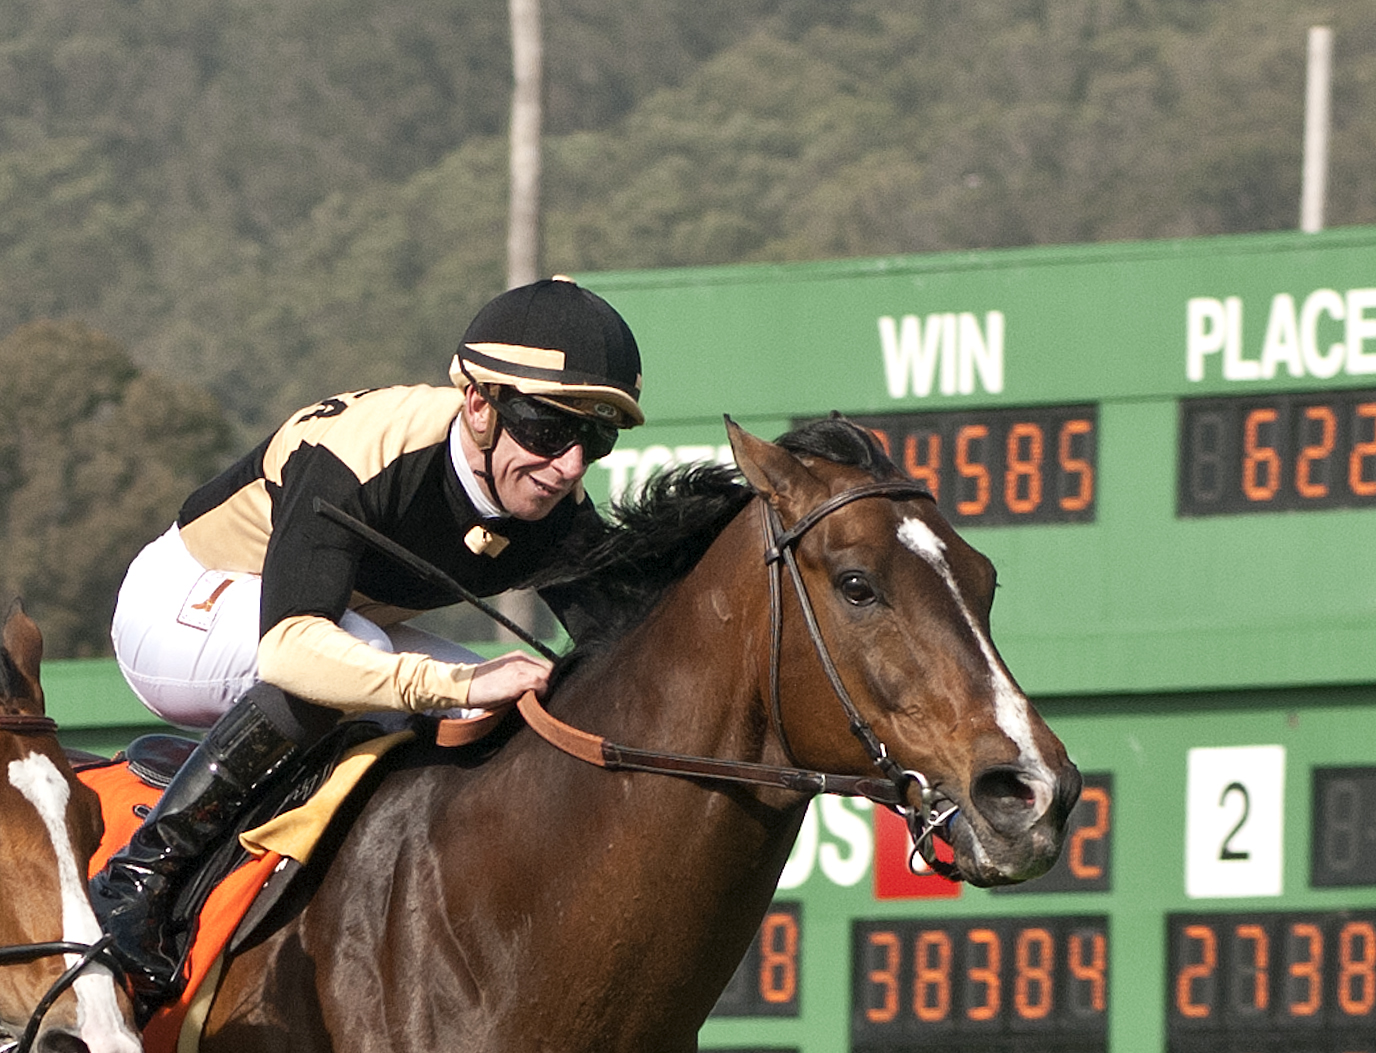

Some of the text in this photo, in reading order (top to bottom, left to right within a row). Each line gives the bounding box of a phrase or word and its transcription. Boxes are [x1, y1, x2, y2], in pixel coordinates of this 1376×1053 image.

[878, 287, 1376, 399] WIN PLACE
[871, 428, 1095, 516] 4585
[1218, 781, 1251, 861] 2
[866, 920, 1376, 1022] 38384 2738
